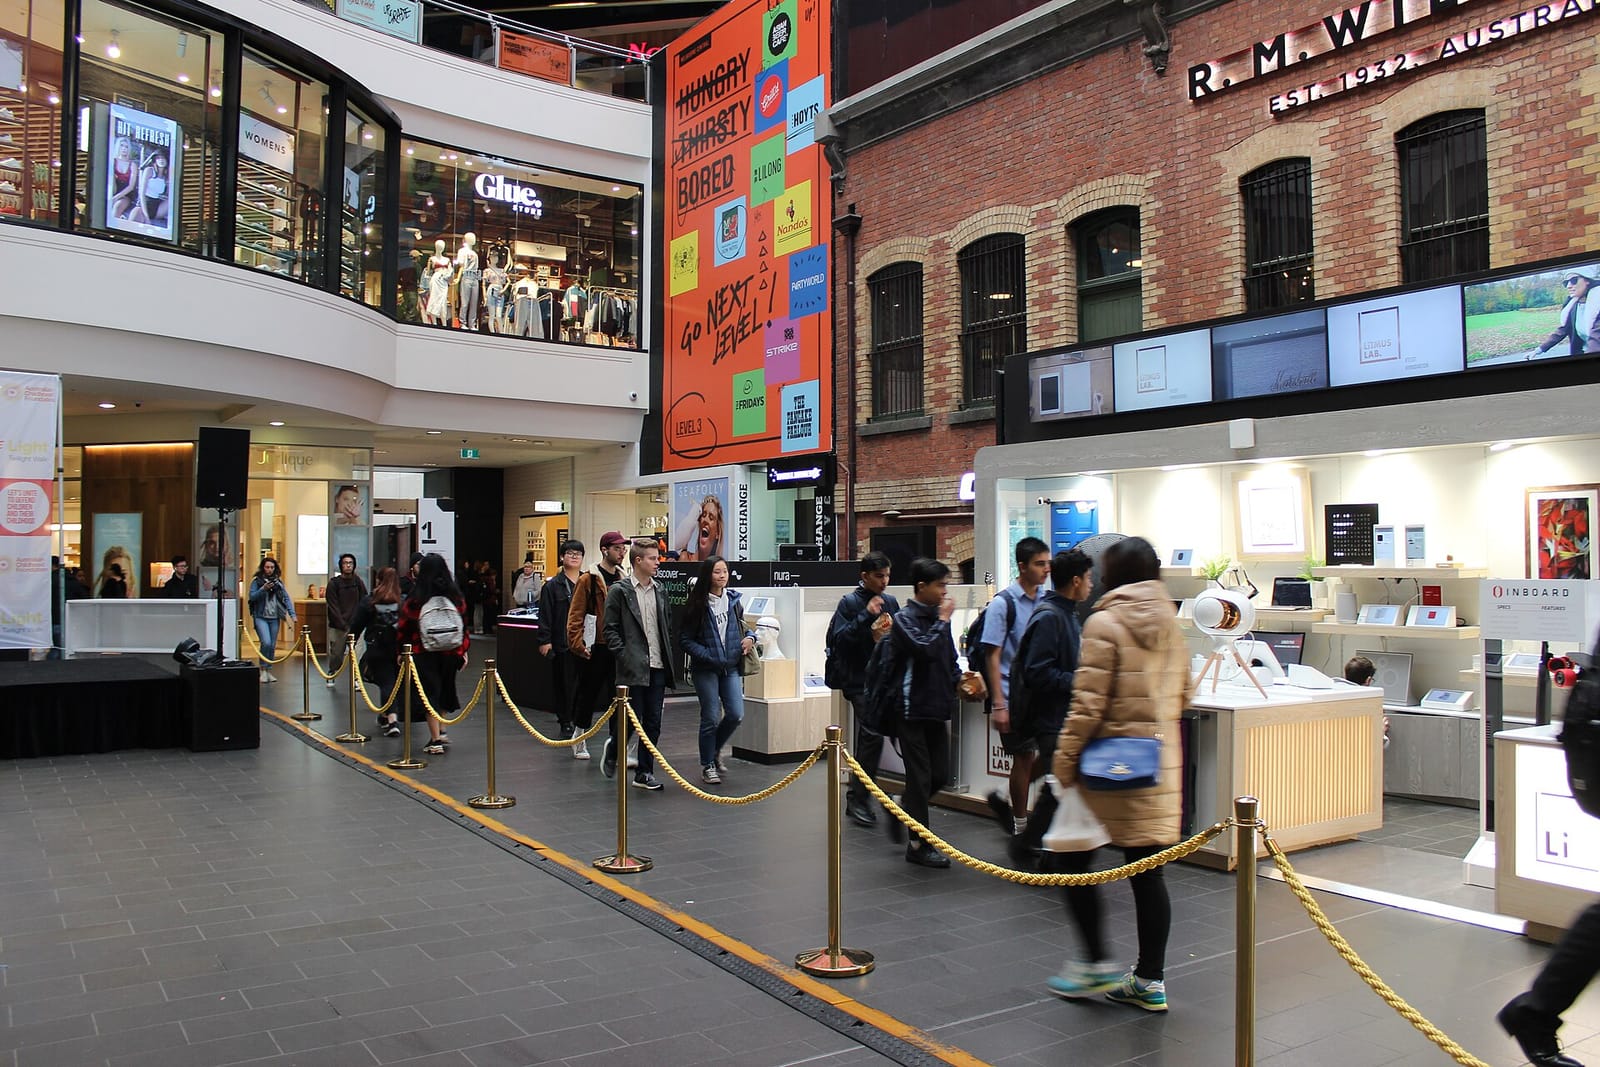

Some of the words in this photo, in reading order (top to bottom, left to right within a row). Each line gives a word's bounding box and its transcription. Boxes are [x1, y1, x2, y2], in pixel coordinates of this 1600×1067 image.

[677, 47, 751, 119] HUNGRY
[1269, 83, 1323, 114] EST.
[1340, 53, 1419, 90] 1932.
[793, 103, 819, 127] HOYTS
[117, 121, 131, 137] HIT
[135, 125, 170, 147] REFRESH
[677, 95, 751, 162] THIRSTY
[244, 130, 286, 154] WOMENS
[678, 154, 736, 209] BORED
[512, 204, 542, 217] STORE
[777, 217, 809, 237] Nando's
[791, 273, 825, 292] PARTYWORLD
[706, 275, 754, 336] NEXT
[681, 321, 702, 356] GO
[766, 342, 798, 357] STRIKE
[675, 419, 696, 436] LEVEL
[696, 417, 702, 433] 3
[679, 482, 724, 497] SEAFOLLY
[738, 483, 748, 551] EXCHANGE
[1506, 588, 1569, 597] INBOARD
